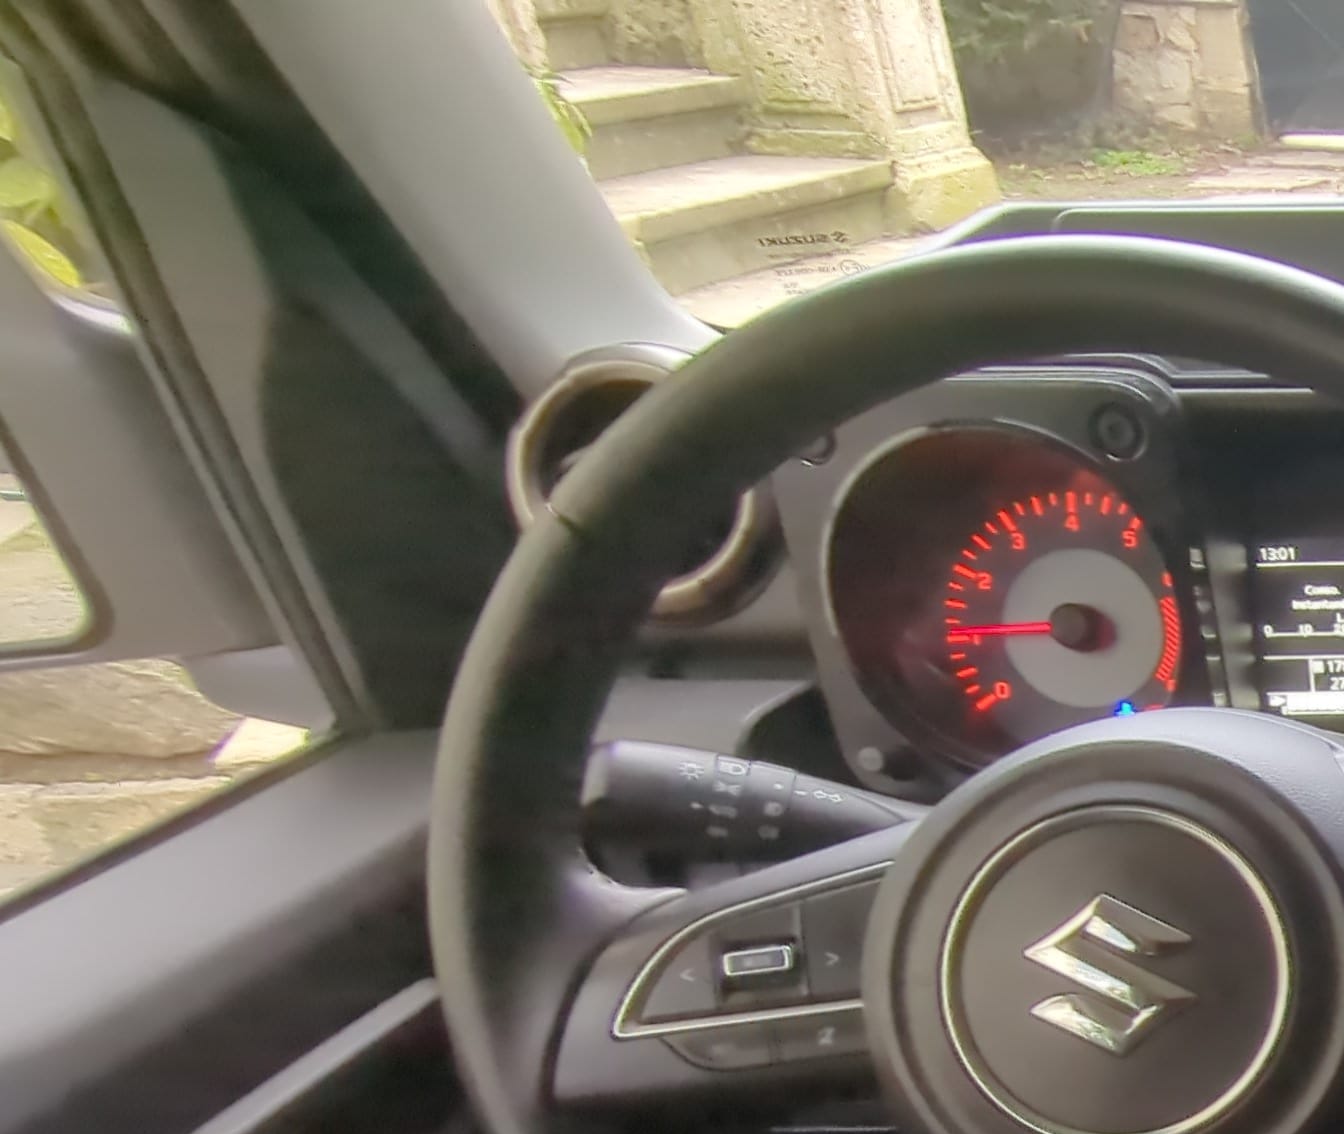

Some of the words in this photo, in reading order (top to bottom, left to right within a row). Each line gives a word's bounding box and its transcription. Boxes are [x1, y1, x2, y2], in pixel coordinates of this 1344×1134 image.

[1065, 514, 1080, 531] 4
[1011, 532, 1025, 550] 3
[1122, 530, 1138, 548] 5
[977, 572, 992, 590] 2
[995, 682, 1009, 698] 0
